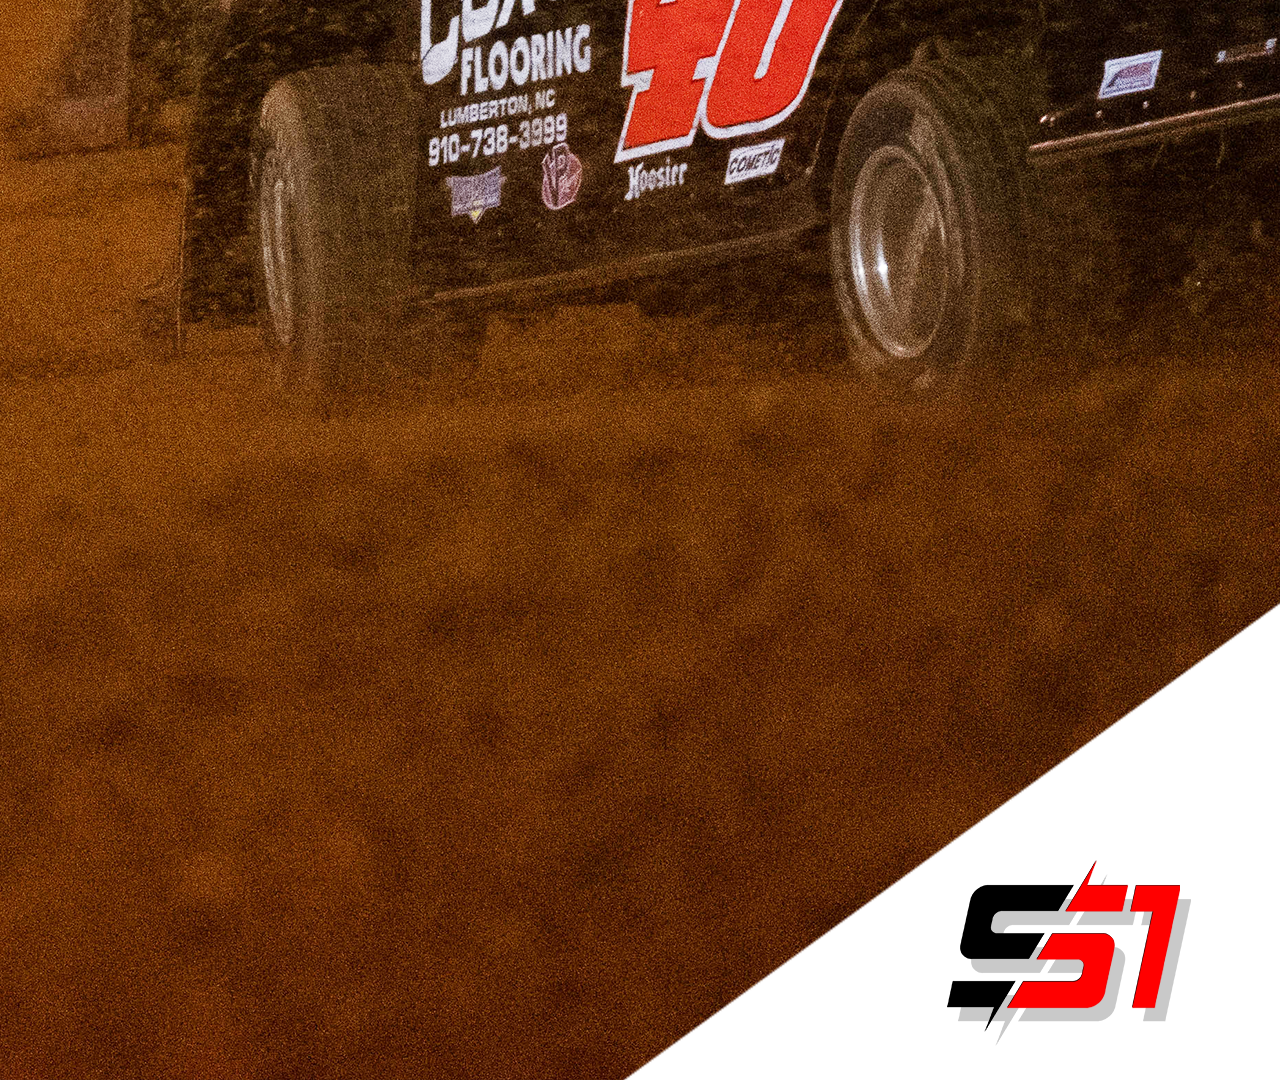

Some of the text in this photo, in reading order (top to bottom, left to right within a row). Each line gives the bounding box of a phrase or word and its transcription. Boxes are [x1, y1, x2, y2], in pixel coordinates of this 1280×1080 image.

[460, 23, 591, 96] FLOORING
[535, 88, 556, 113] NC
[428, 112, 568, 167] 910-738-3999
[727, 143, 783, 177] COMETIC
